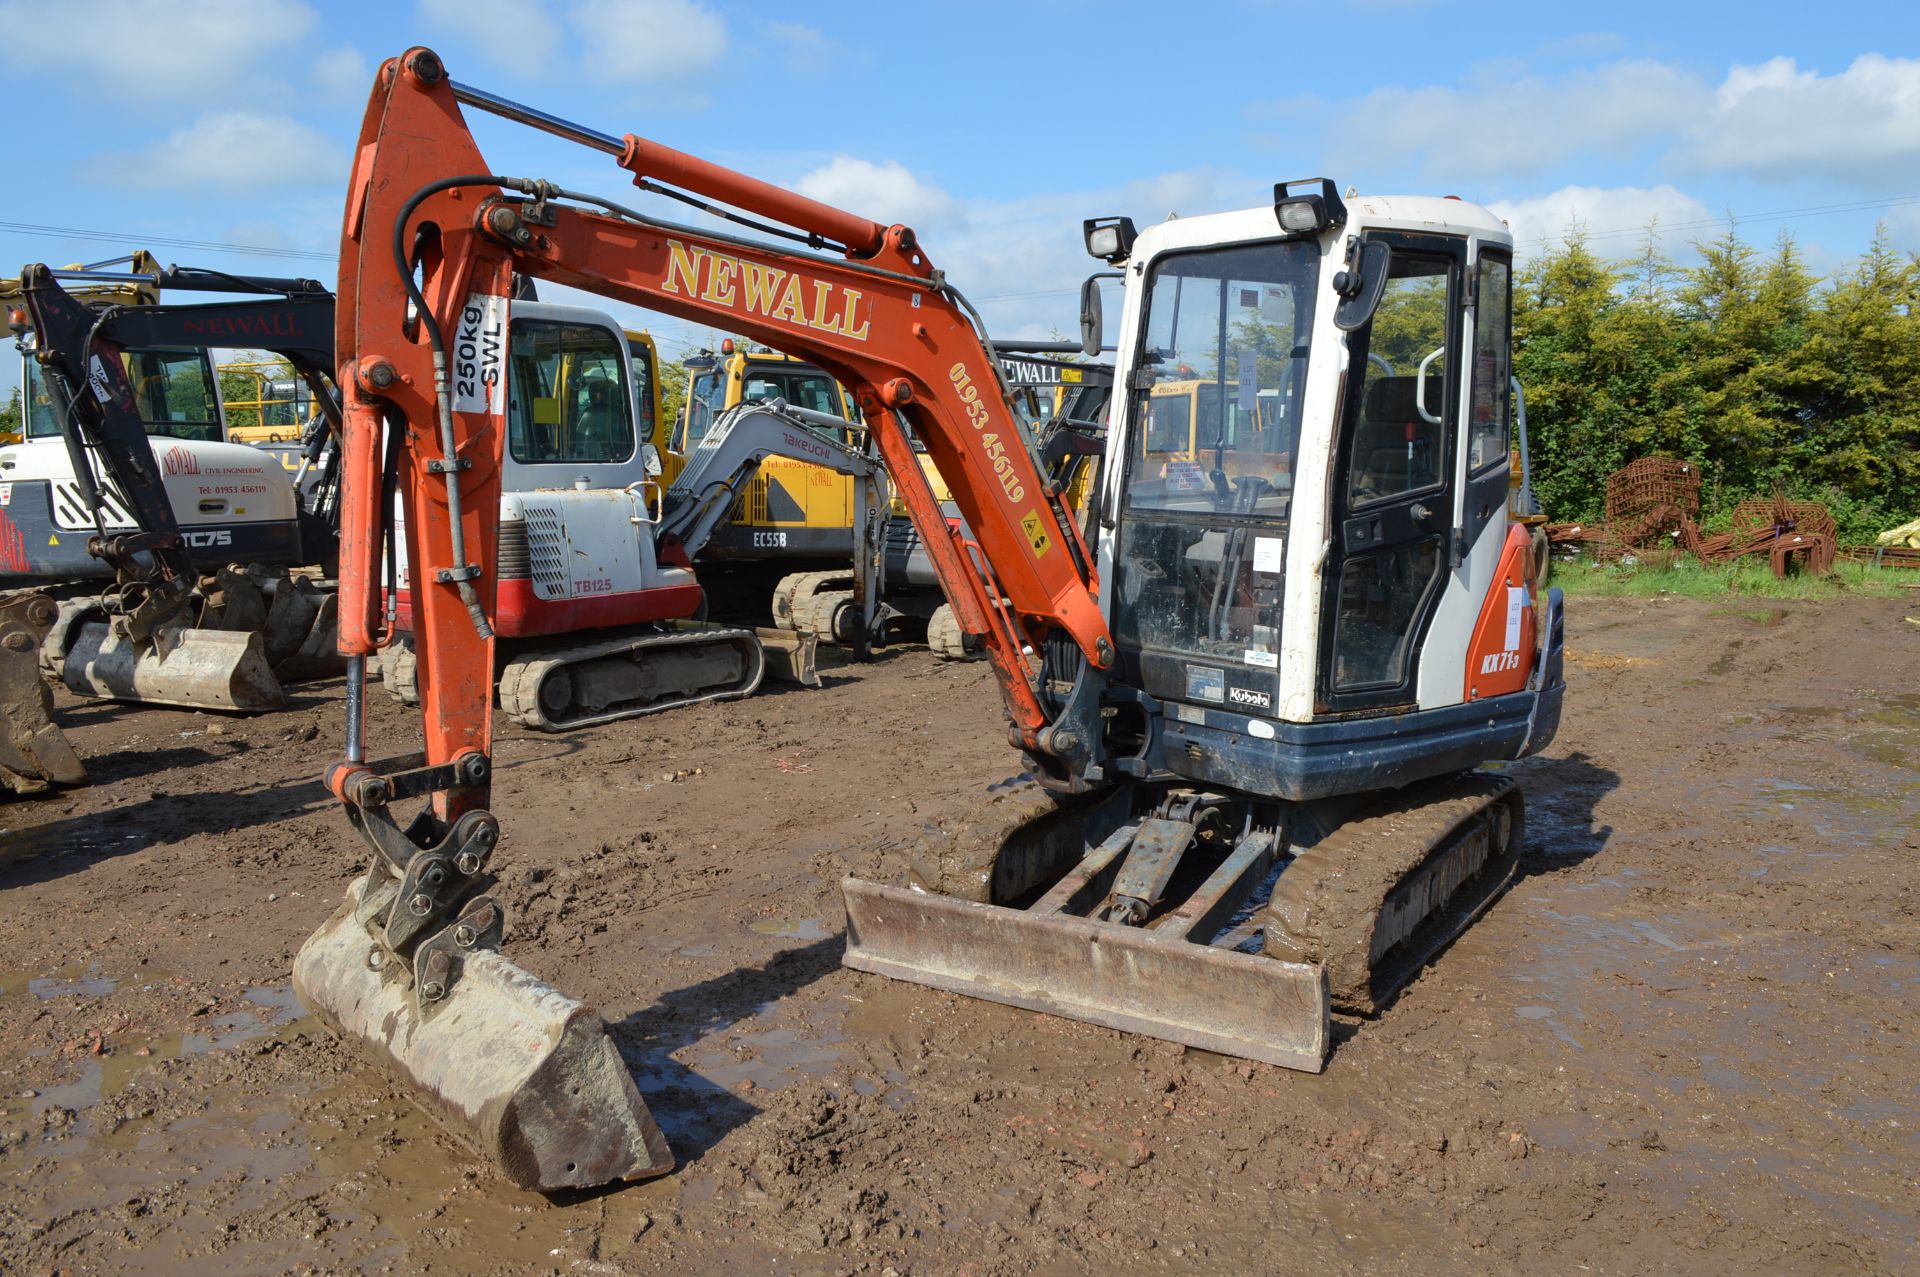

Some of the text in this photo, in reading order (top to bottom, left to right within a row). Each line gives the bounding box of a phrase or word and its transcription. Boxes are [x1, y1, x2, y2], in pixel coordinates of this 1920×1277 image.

[661, 239, 870, 341] NEWALL
[183, 312, 304, 336] NEWALL
[457, 307, 482, 398] 250kg
[481, 323, 501, 387] SWL
[1000, 359, 1060, 383] EWALL
[949, 362, 1025, 503] 01953 456119
[164, 446, 201, 475] NEWALL
[198, 485, 267, 495] Tel: 01953 456119
[753, 532, 787, 547] EC55B
[574, 579, 612, 593] TB125
[1231, 688, 1268, 706] Kubota
